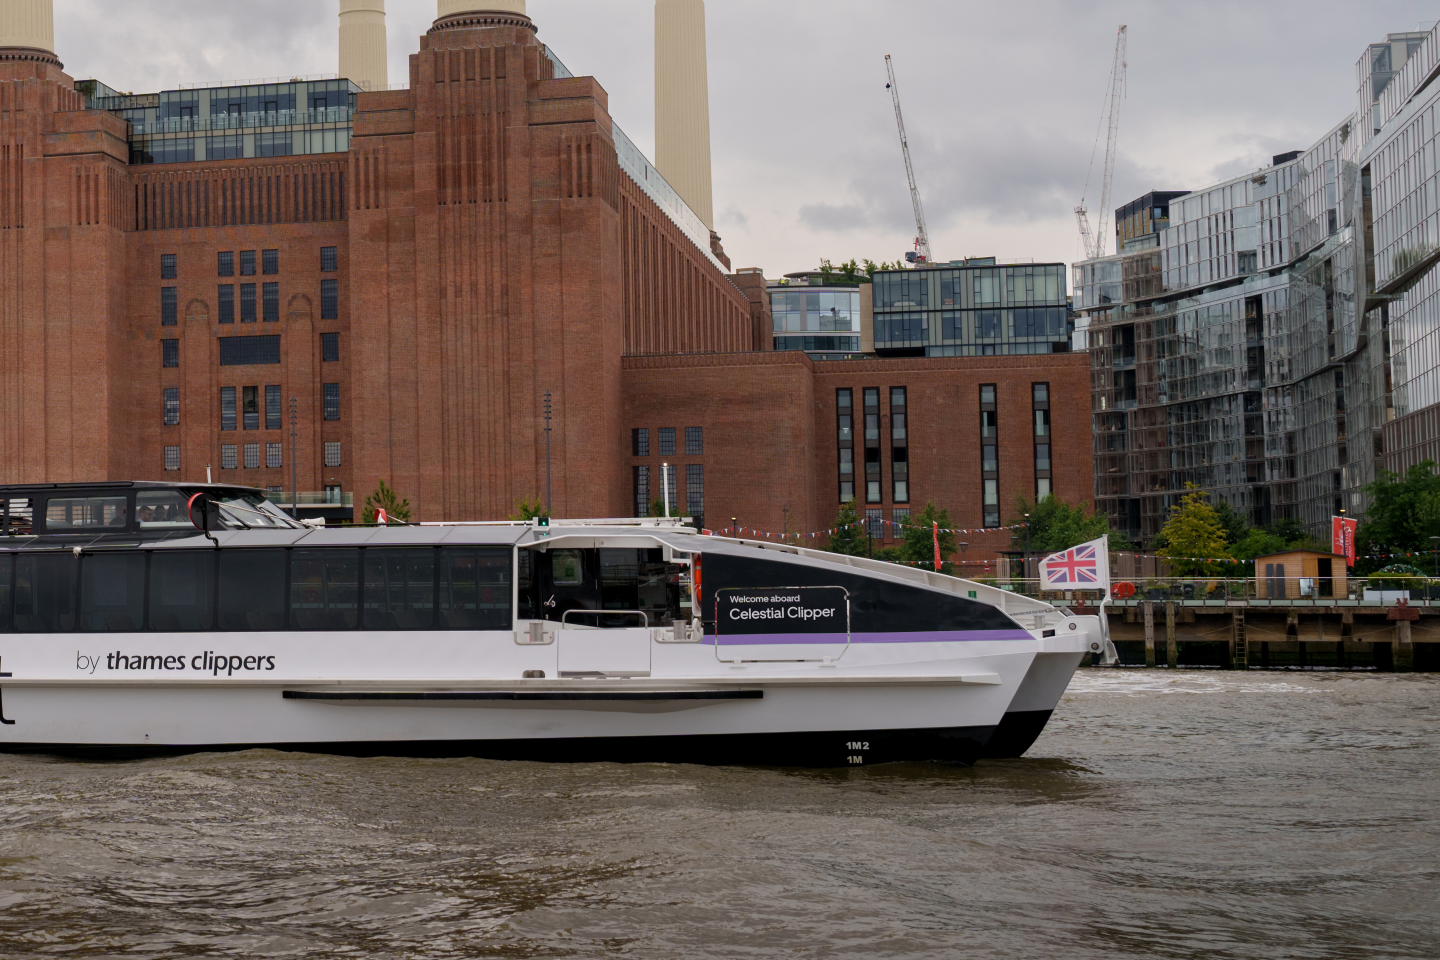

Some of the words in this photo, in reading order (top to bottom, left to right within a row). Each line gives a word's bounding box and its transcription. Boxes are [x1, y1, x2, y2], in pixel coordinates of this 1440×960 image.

[729, 595, 768, 603] Welcome
[770, 594, 800, 602] aboard
[729, 607, 784, 620] Celestial
[787, 606, 836, 620] Clipper
[76, 650, 100, 674] by
[106, 650, 186, 670] thames
[191, 650, 276, 676] clippers
[847, 756, 862, 764] 1M
